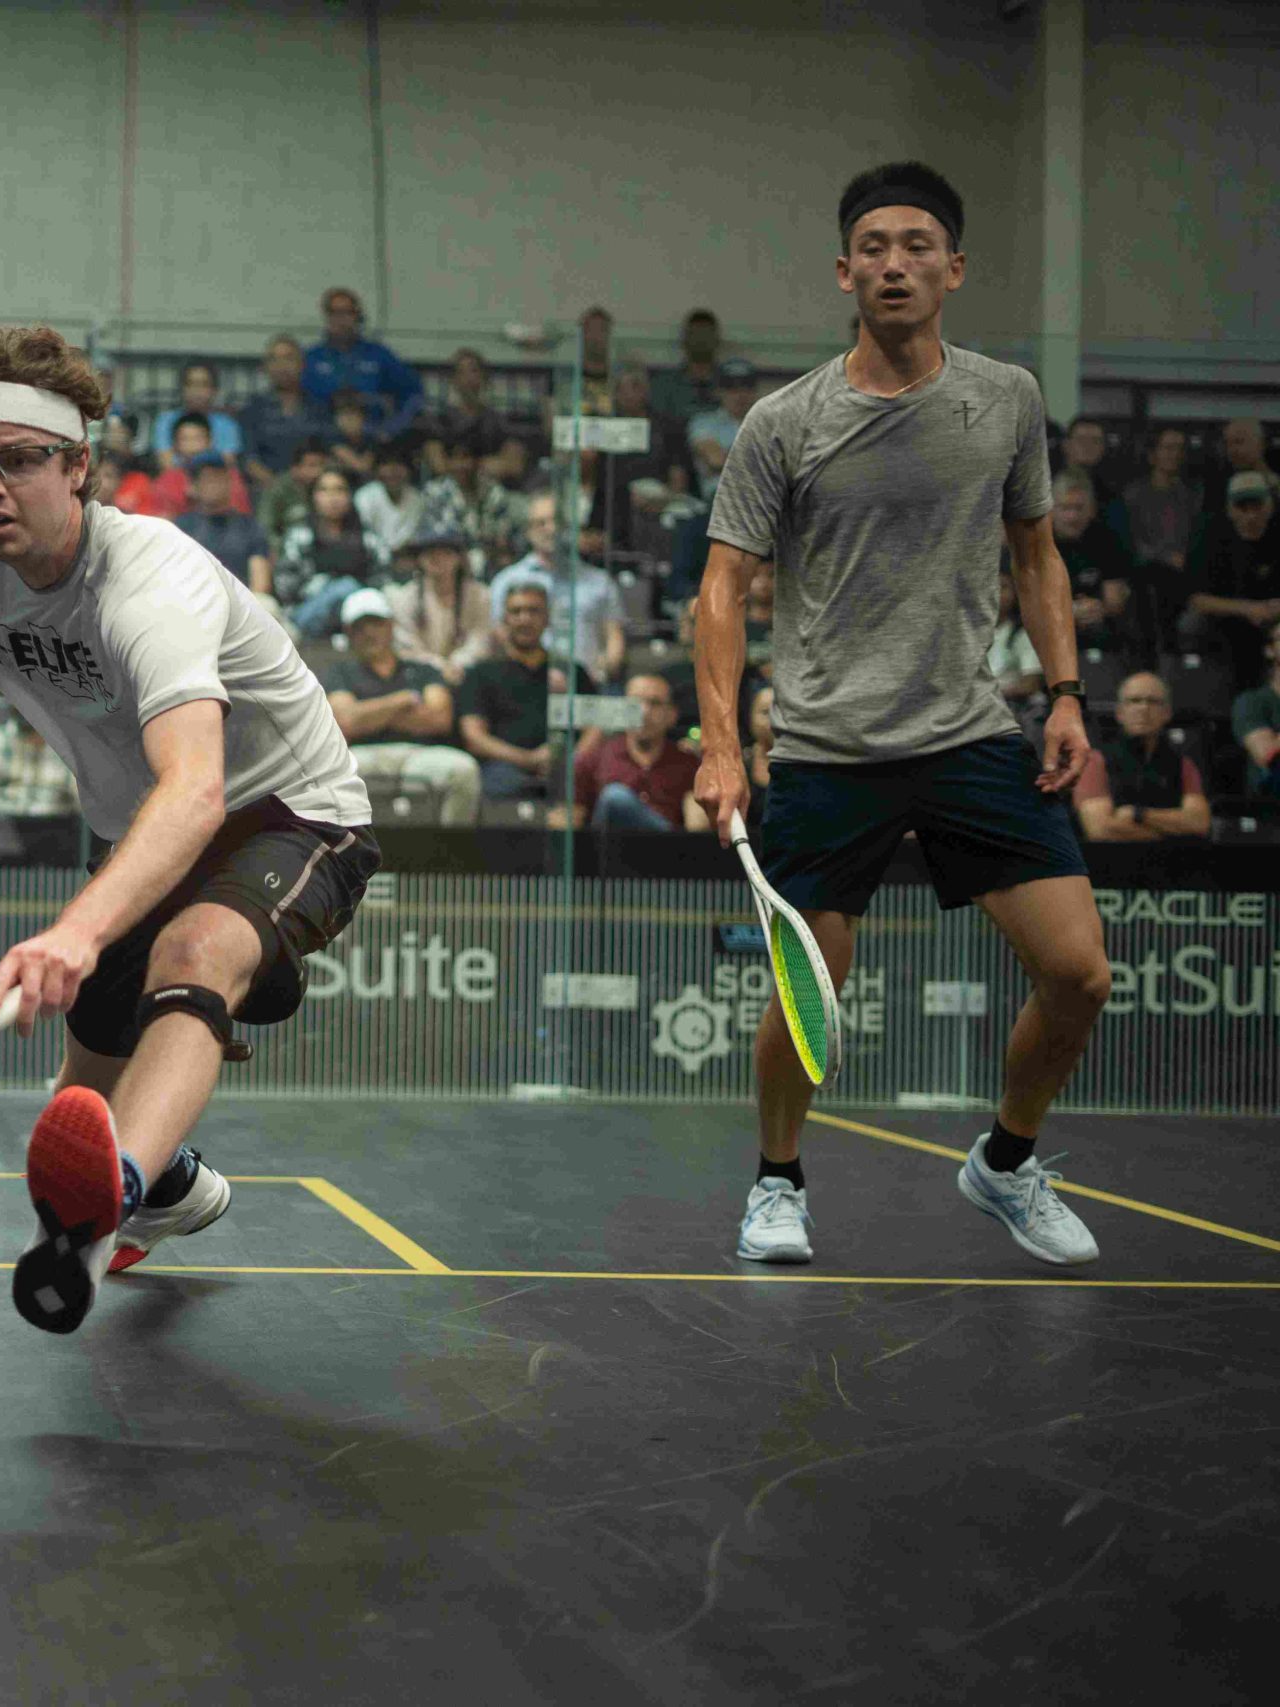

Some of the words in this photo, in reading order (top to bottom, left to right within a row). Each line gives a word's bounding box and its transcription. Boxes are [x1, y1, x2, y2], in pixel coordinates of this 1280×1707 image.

[1092, 888, 1266, 926] RACLE
[303, 931, 497, 1000] Suite
[714, 964, 885, 998] SQSH
[1104, 944, 1280, 1016] etSui
[739, 1001, 885, 1032] ENE
